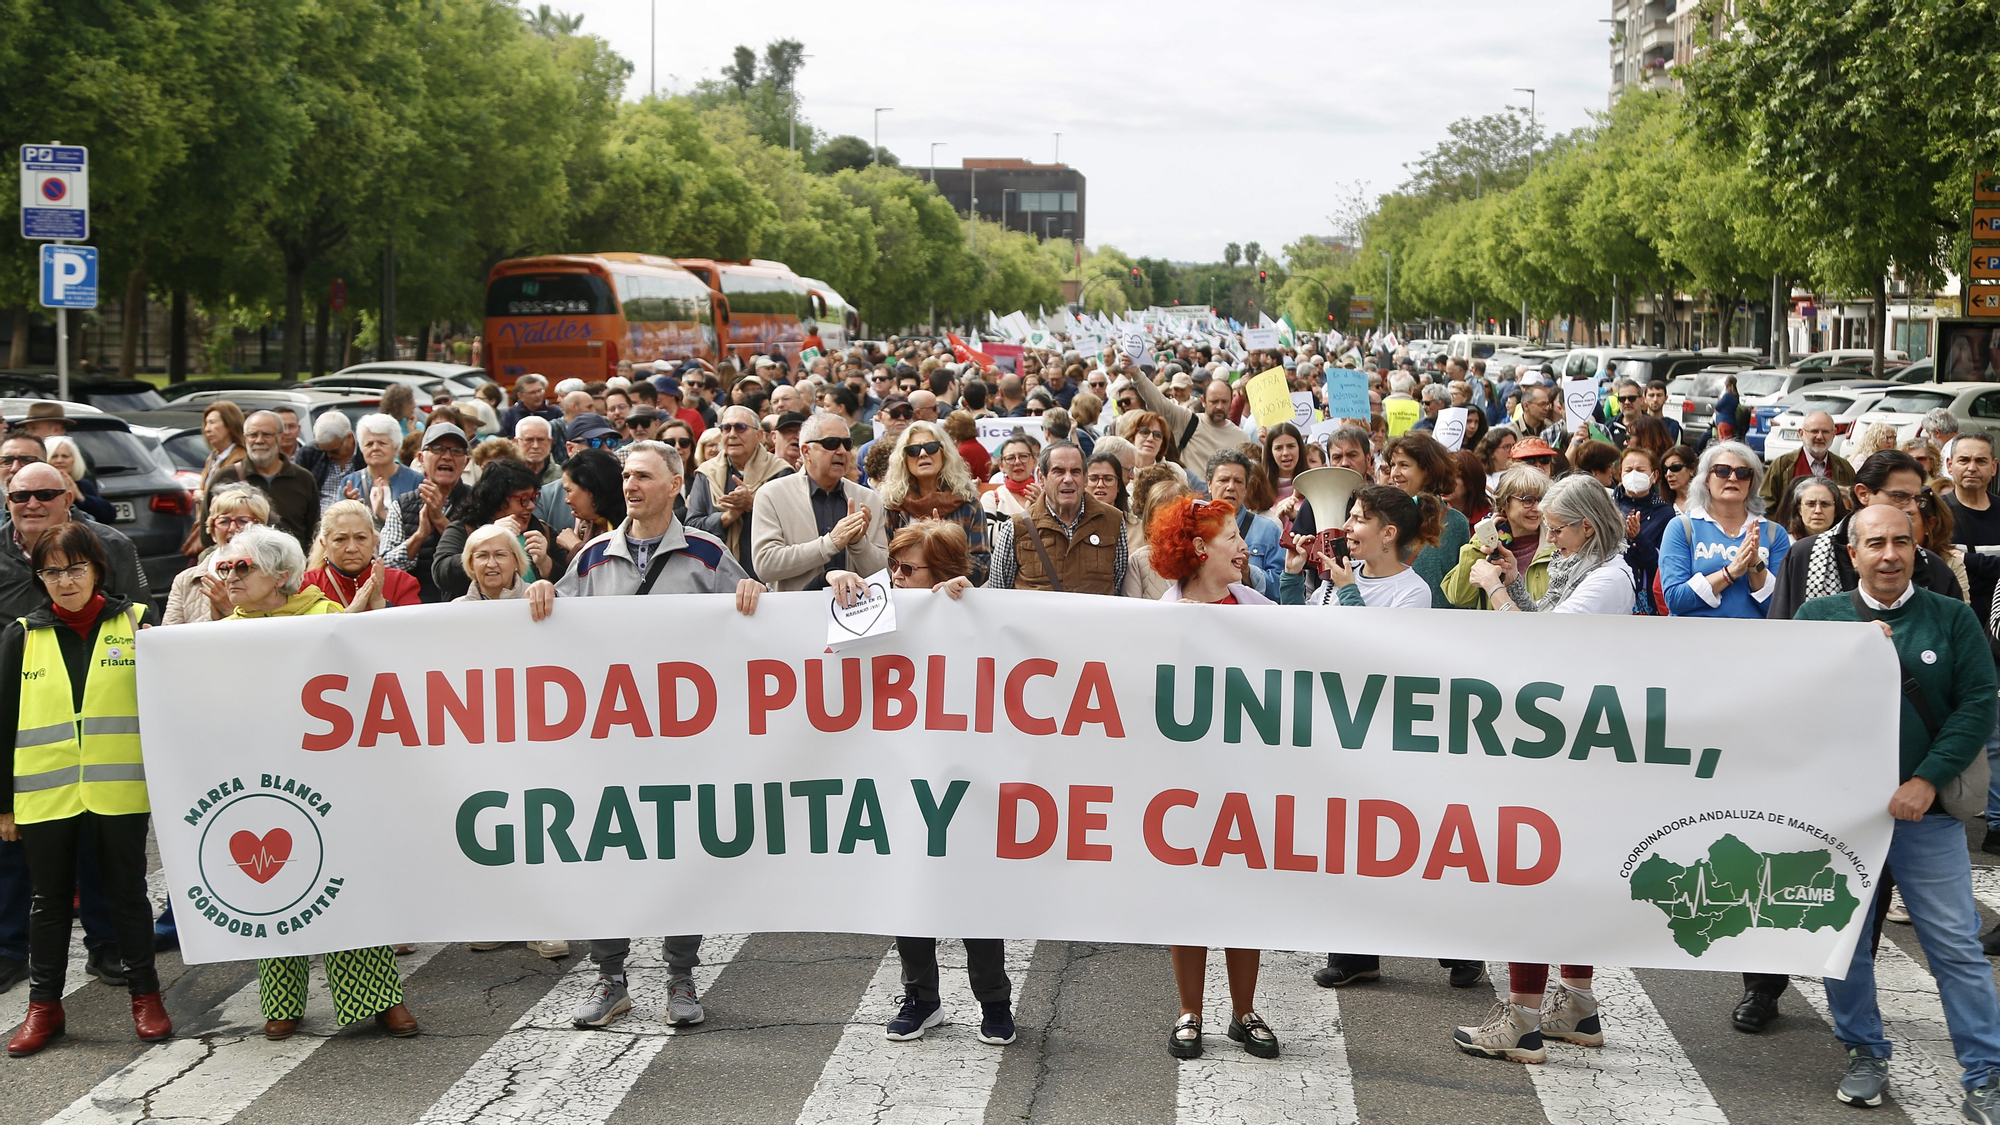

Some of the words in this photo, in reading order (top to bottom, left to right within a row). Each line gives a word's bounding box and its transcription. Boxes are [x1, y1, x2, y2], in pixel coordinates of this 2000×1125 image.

[26, 148, 37, 161] P
[53, 253, 87, 299] P
[1990, 258, 1999, 268] P
[499, 319, 600, 349] Valdés
[1694, 541, 1770, 566] AMOR
[302, 662, 718, 752] SANIDAD
[747, 646, 1126, 739] PÚBLICA
[1155, 664, 1721, 778] UNIVERSAL,
[184, 777, 245, 827] MAREA
[260, 773, 333, 818] BLANCA
[456, 778, 891, 866] GRATUITA
[911, 778, 971, 857] Y
[996, 782, 1114, 862] DE
[1143, 788, 1562, 886] CALIDAD
[1619, 815, 1698, 879] COORDINADORA
[1699, 809, 1765, 823] ANDALUZA
[1768, 812, 1785, 825] DE
[1787, 817, 1837, 846] MAREAS
[1835, 841, 1872, 889] BLANCAS
[187, 885, 268, 938] CÓRDOBA
[276, 876, 345, 936] CAPITAL
[1783, 887, 1835, 902] CAMB
